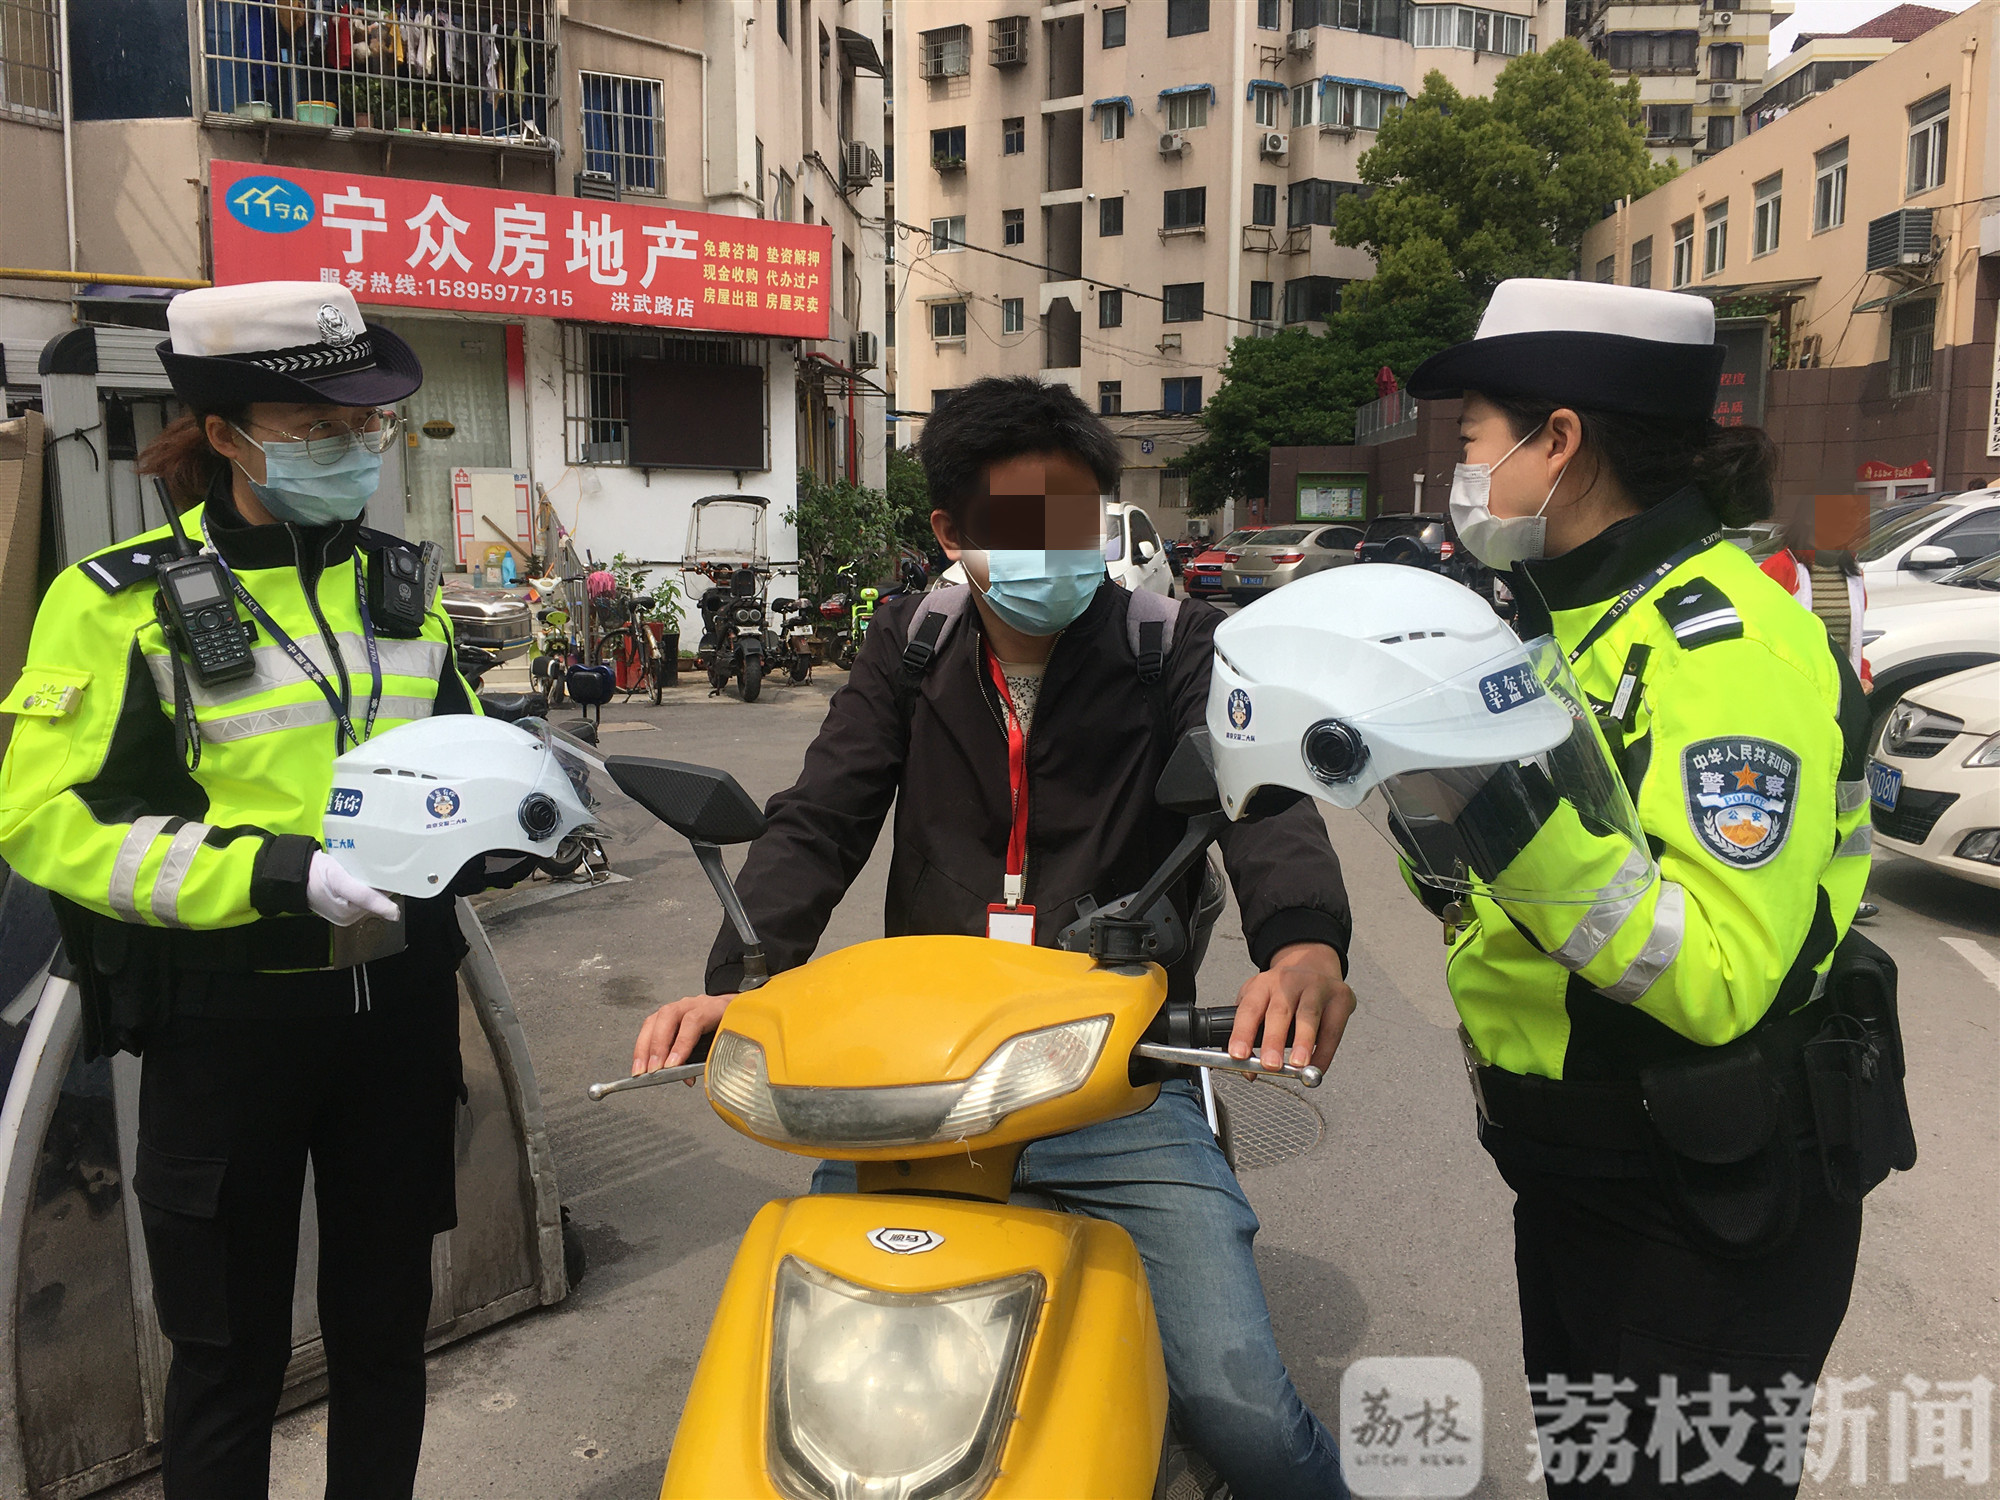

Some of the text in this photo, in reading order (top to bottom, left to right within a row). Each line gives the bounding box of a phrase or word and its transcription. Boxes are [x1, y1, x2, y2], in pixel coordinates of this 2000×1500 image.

[274, 203, 309, 221] 宁众
[322, 185, 699, 290] 宁众房地产
[703, 239, 820, 268] 免费咨询 垫资解押
[703, 264, 819, 290] 现金收购 代办过户
[610, 291, 694, 318] 洪武路店
[703, 287, 819, 314] 房屋出租 房屋买卖
[425, 558, 439, 598] POLICE
[233, 584, 261, 615] POLICE
[1609, 583, 1646, 618] POLICE
[287, 643, 324, 684] 中国警察
[366, 635, 379, 664] POLICE
[1693, 744, 1791, 777] 中华人民共和国
[1723, 795, 1766, 808] POLICE
